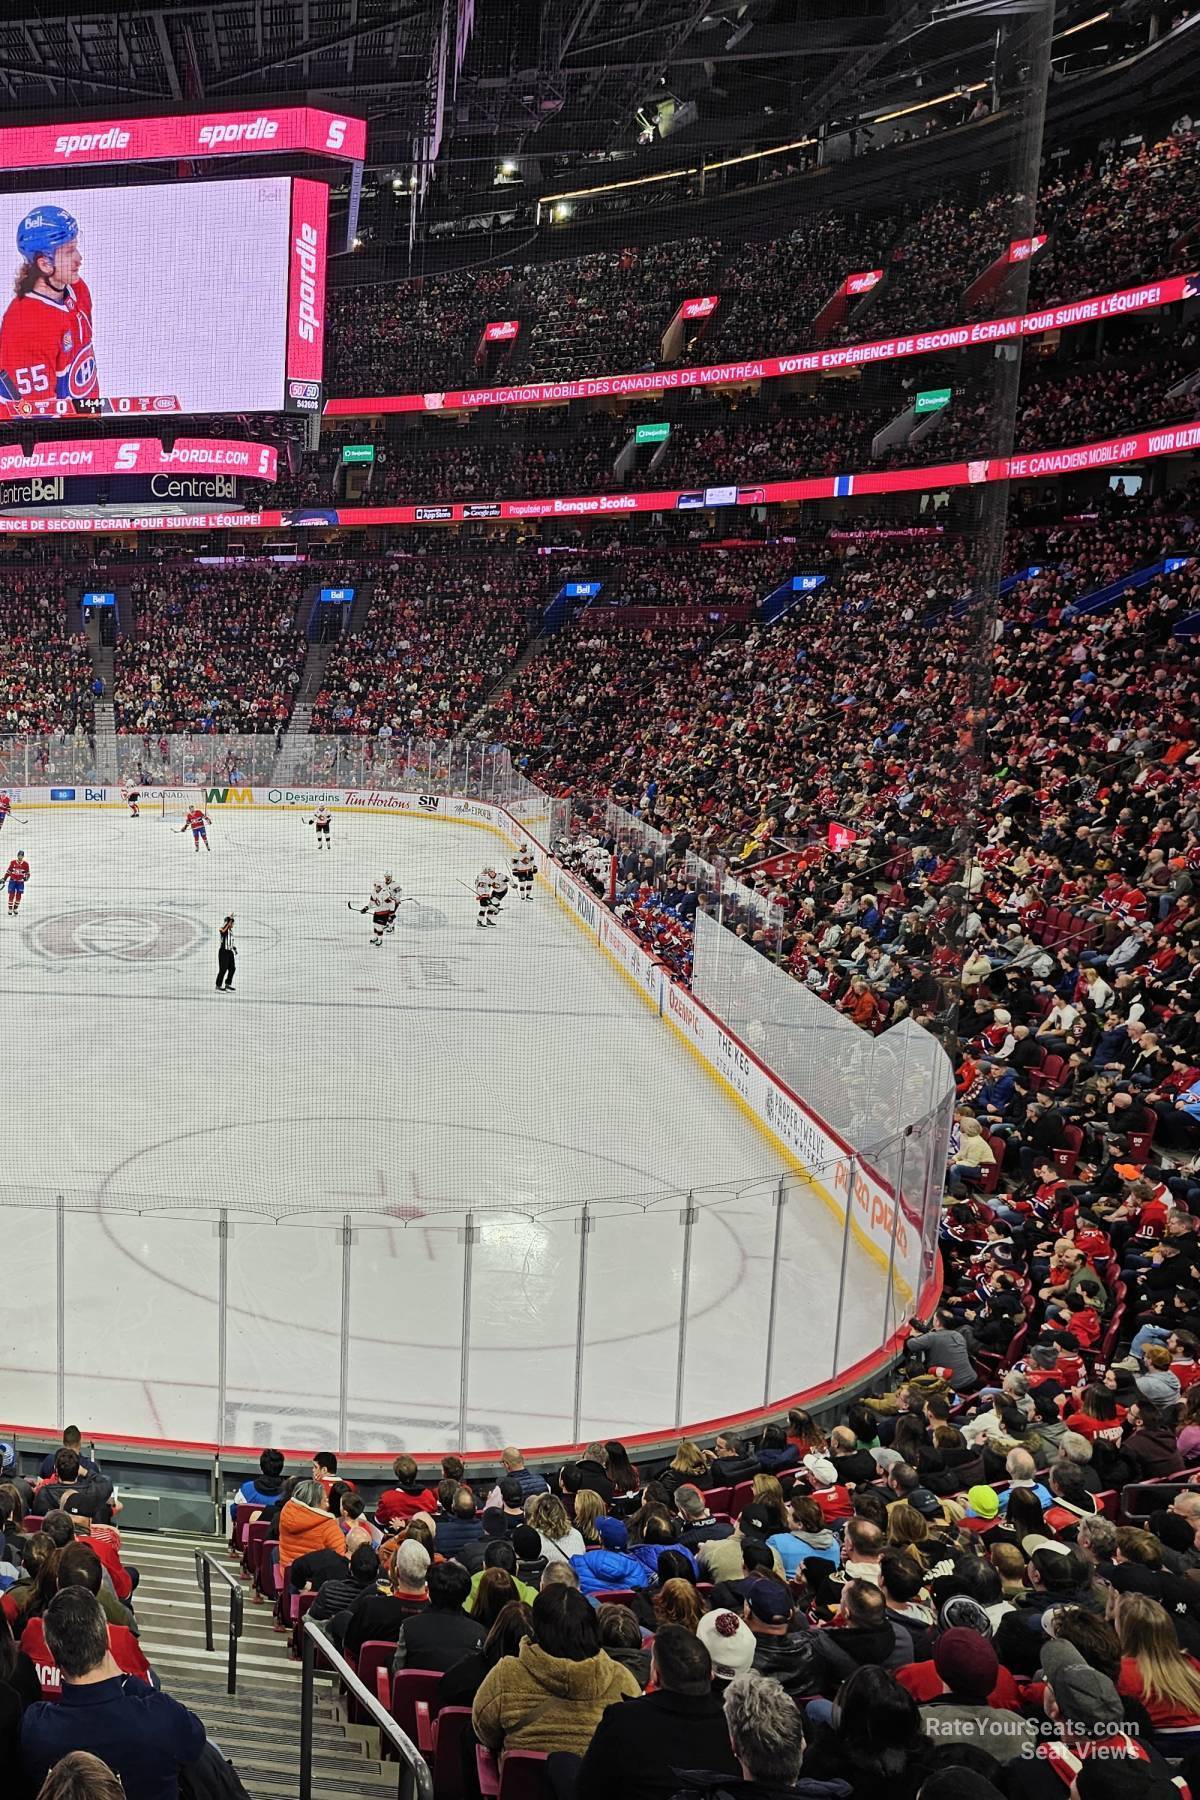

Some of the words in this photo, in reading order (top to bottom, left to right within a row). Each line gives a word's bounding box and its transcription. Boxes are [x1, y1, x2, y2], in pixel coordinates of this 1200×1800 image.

[198, 118, 278, 148] spordle
[326, 120, 347, 150] S
[54, 128, 130, 157] spordle
[25, 216, 43, 230] Bell
[296, 222, 320, 343] spordle
[462, 388, 540, 406] L'APPLICATION
[542, 383, 584, 399] MOBILE
[588, 382, 610, 395] DES
[612, 374, 678, 393] CANADIENS
[680, 372, 696, 384] DE
[707, 364, 766, 382] MONTRÉAL
[779, 358, 819, 374] VOTRE
[822, 340, 895, 368] EXPÉRIENCE
[897, 340, 914, 354] DE
[916, 331, 968, 350] SECOND
[971, 322, 1016, 342] ÉCRAN
[1020, 315, 1054, 332] POUR
[1056, 305, 1098, 326] SUIVRE
[1100, 288, 1161, 314] L'ÉQUIPE!
[16, 364, 49, 394] 55
[291, 384, 316, 397] 50/50
[56, 401, 66, 414] 0
[119, 398, 130, 412] 0
[115, 443, 140, 470] S
[160, 450, 248, 465] SPORDLE.COM
[1006, 460, 1027, 475] THE
[1029, 450, 1088, 473] CANADIENS
[1088, 444, 1118, 464] MOBILE
[1120, 441, 1137, 457] APP
[1148, 436, 1174, 453] YOUR
[1176, 427, 1200, 447] ULTI
[0, 450, 93, 472] SPORDLE.COM
[259, 450, 269, 473] S
[509, 505, 541, 518] Propulsée
[542, 506, 552, 516] par
[554, 500, 598, 514] Banque
[30, 520, 45, 530] DE
[47, 519, 91, 530] SECOND
[133, 518, 164, 528] POUR
[166, 515, 206, 527] SUIVRE
[209, 515, 260, 526] L'ÉQUIPE!
[577, 585, 590, 594] Bell
[803, 578, 816, 588] Bell
[93, 594, 105, 603] Bell
[331, 590, 344, 599] Bell
[85, 788, 106, 801] Bell
[207, 788, 254, 803] WM
[286, 792, 340, 803] Desjardins
[344, 791, 365, 806] Tim
[367, 796, 410, 810] Hortons
[418, 796, 439, 808] SN
[669, 987, 698, 1034] OZEMPIC
[718, 1030, 732, 1058] THE
[734, 1048, 749, 1075] KEG
[800, 1118, 824, 1159] TWELVE
[1142, 1225, 1154, 1236] 10
